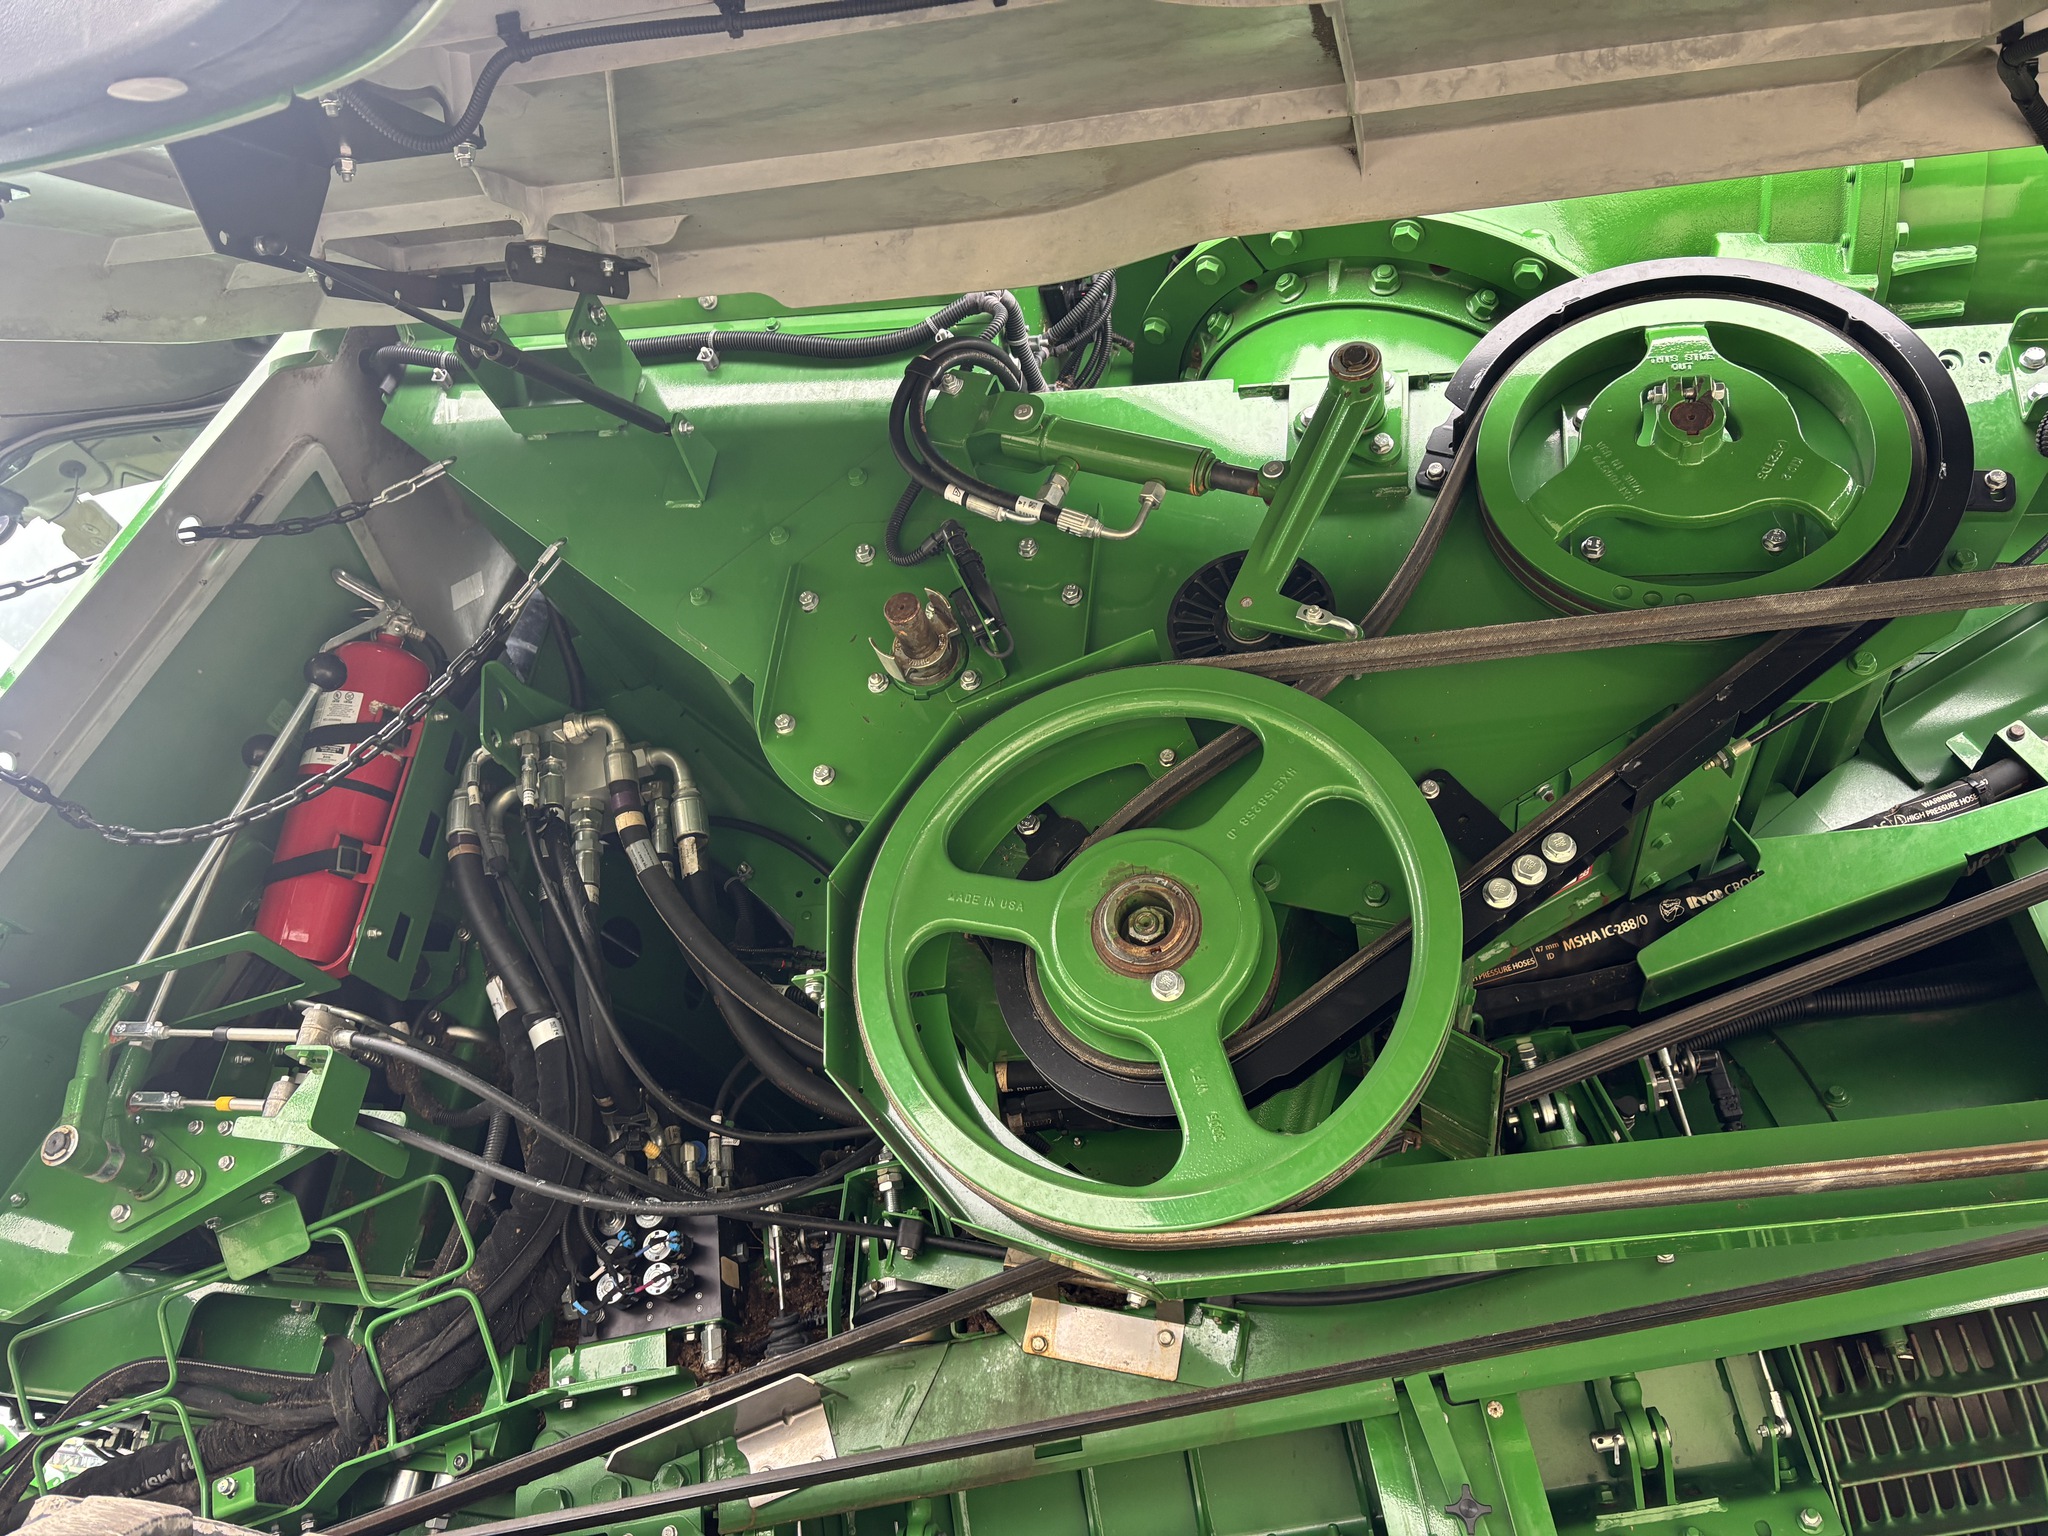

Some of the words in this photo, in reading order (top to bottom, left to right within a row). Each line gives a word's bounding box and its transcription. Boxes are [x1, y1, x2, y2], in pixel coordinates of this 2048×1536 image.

[1239, 767, 1297, 826] HXE158258
[1922, 791, 1957, 808] WARNING
[1907, 811, 1926, 822] HIGH
[1926, 800, 1961, 817] PRESSURE
[1685, 888, 1724, 910] RYCO
[1724, 871, 1763, 897] CROC
[947, 892, 981, 905] MADE
[984, 895, 996, 907] IN
[1000, 898, 1025, 912] USA
[1562, 928, 1602, 953] MSHA
[1600, 913, 1650, 941] IC-288/0
[1545, 942, 1560, 951] mm
[1546, 952, 1555, 961] ID
[1479, 964, 1513, 980] PRESSURE
[1512, 957, 1536, 970] HOSES
